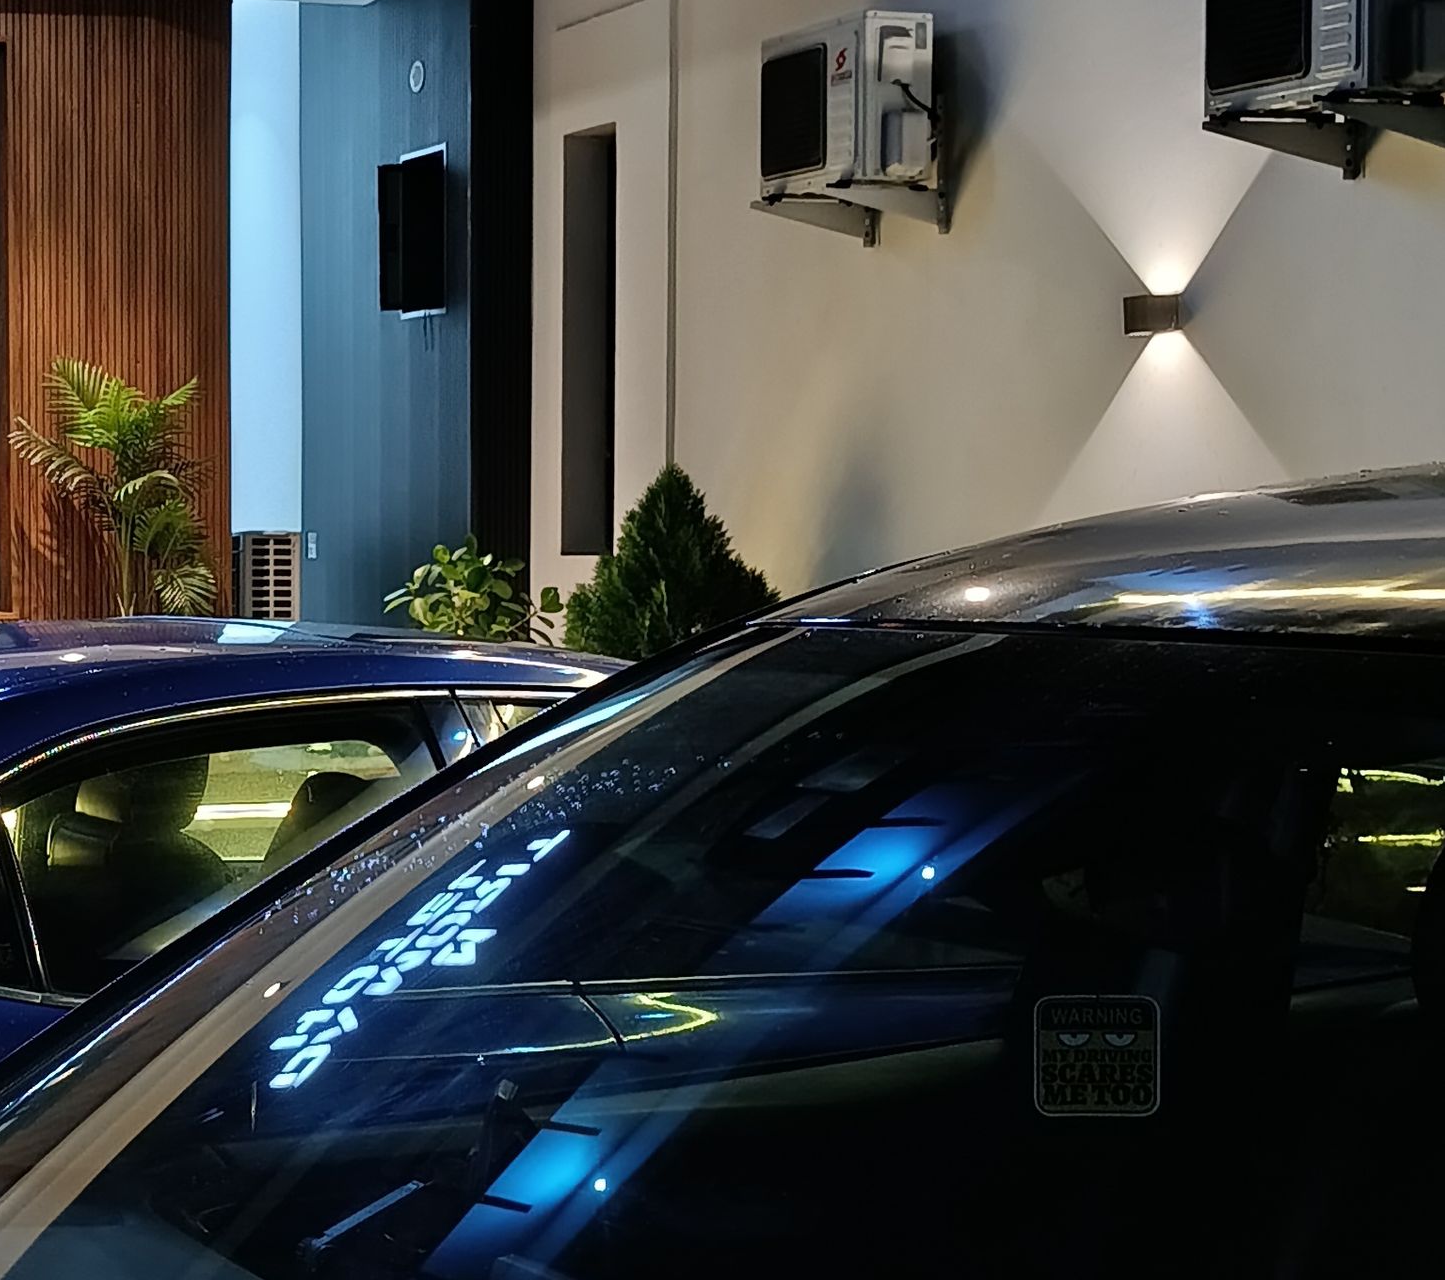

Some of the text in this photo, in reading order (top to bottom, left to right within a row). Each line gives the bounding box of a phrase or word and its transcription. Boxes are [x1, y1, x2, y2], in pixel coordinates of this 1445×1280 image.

[1051, 1007, 1143, 1025] WARNING
[1043, 1050, 1152, 1063] MY DRIVING
[1041, 1064, 1153, 1083] SCARES
[1043, 1084, 1153, 1106] ME TOO
